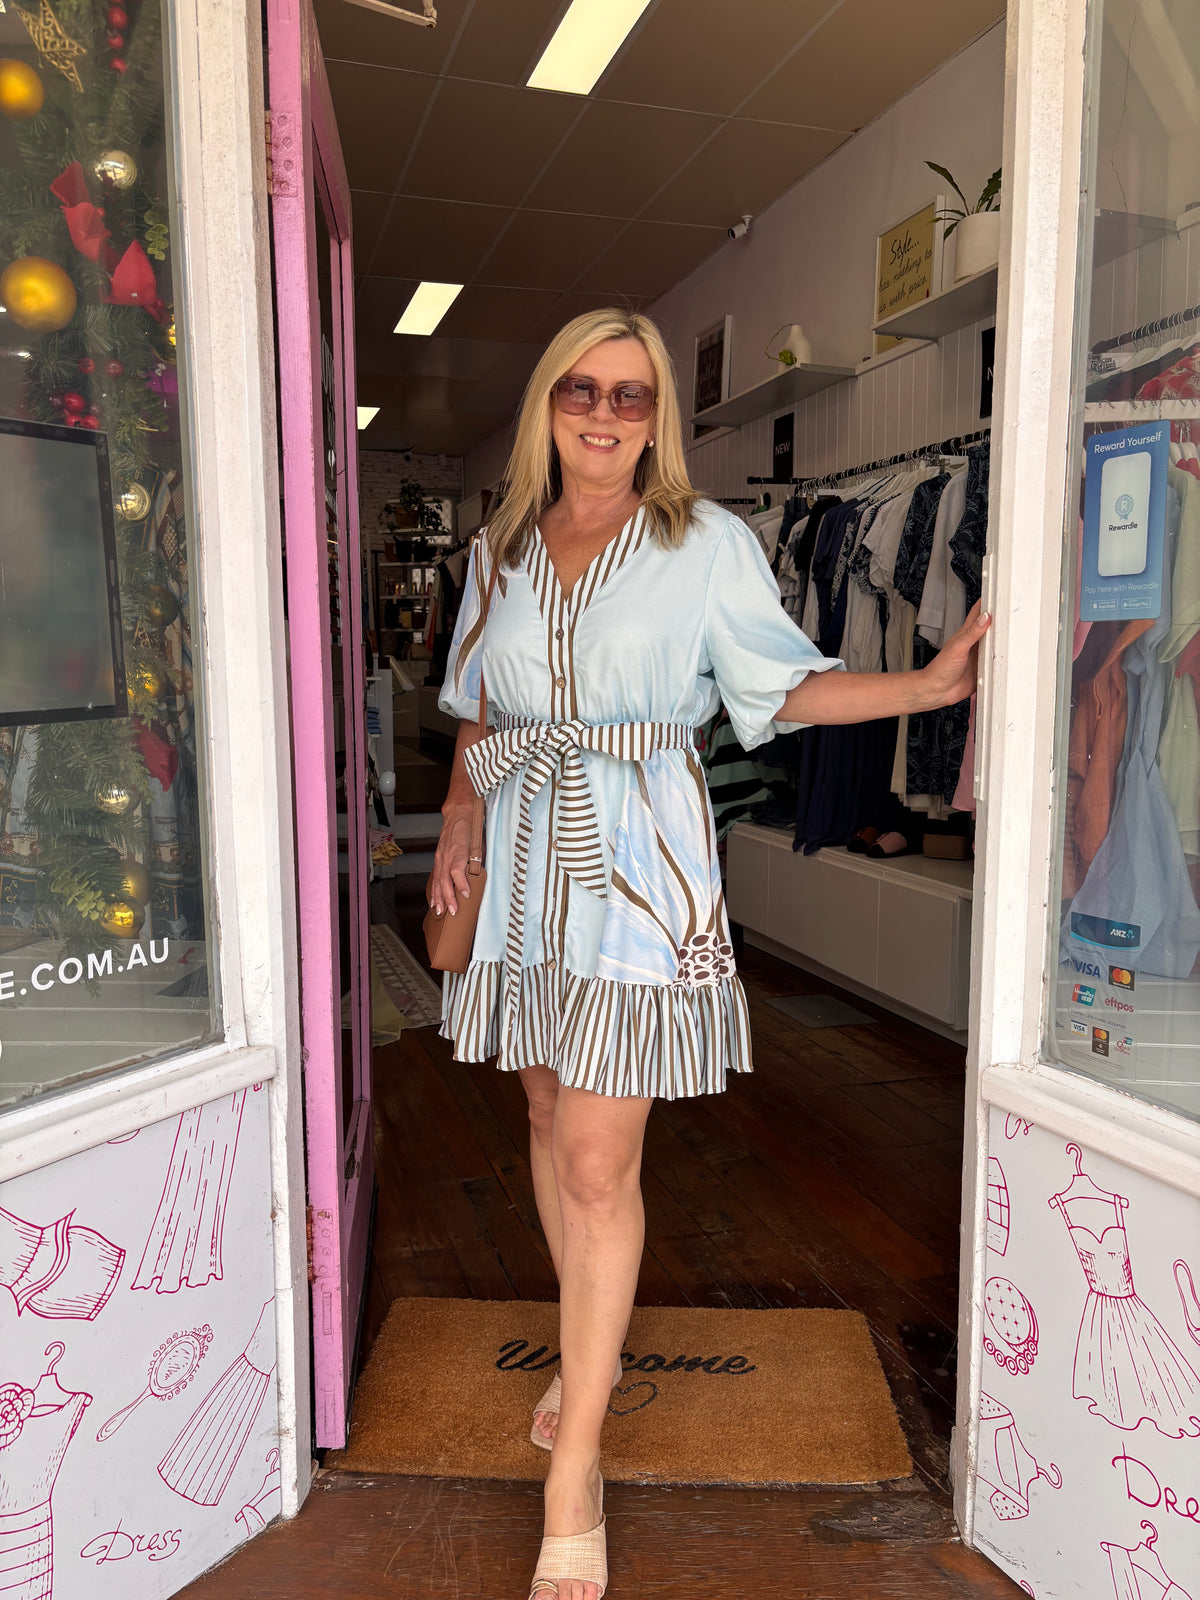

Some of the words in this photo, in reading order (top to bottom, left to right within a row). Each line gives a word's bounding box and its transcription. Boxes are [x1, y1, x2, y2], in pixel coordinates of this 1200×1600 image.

[894, 257, 922, 282] nothing
[925, 248, 933, 260] to
[889, 282, 905, 307] with
[775, 441, 790, 455] NEW
[1094, 438, 1126, 454] Reward
[1127, 431, 1162, 447] Yourself
[1108, 522, 1138, 532] Rewardle
[1084, 586, 1096, 595] Pay
[1098, 585, 1112, 593] here
[1113, 583, 1127, 592] with
[1128, 581, 1159, 591] Rewardle
[1110, 928, 1127, 938] ANZ
[1074, 960, 1101, 978] VISA
[1104, 997, 1135, 1013] eftpos
[1073, 1024, 1086, 1033] VISA
[80, 1518, 182, 1566] Dress
